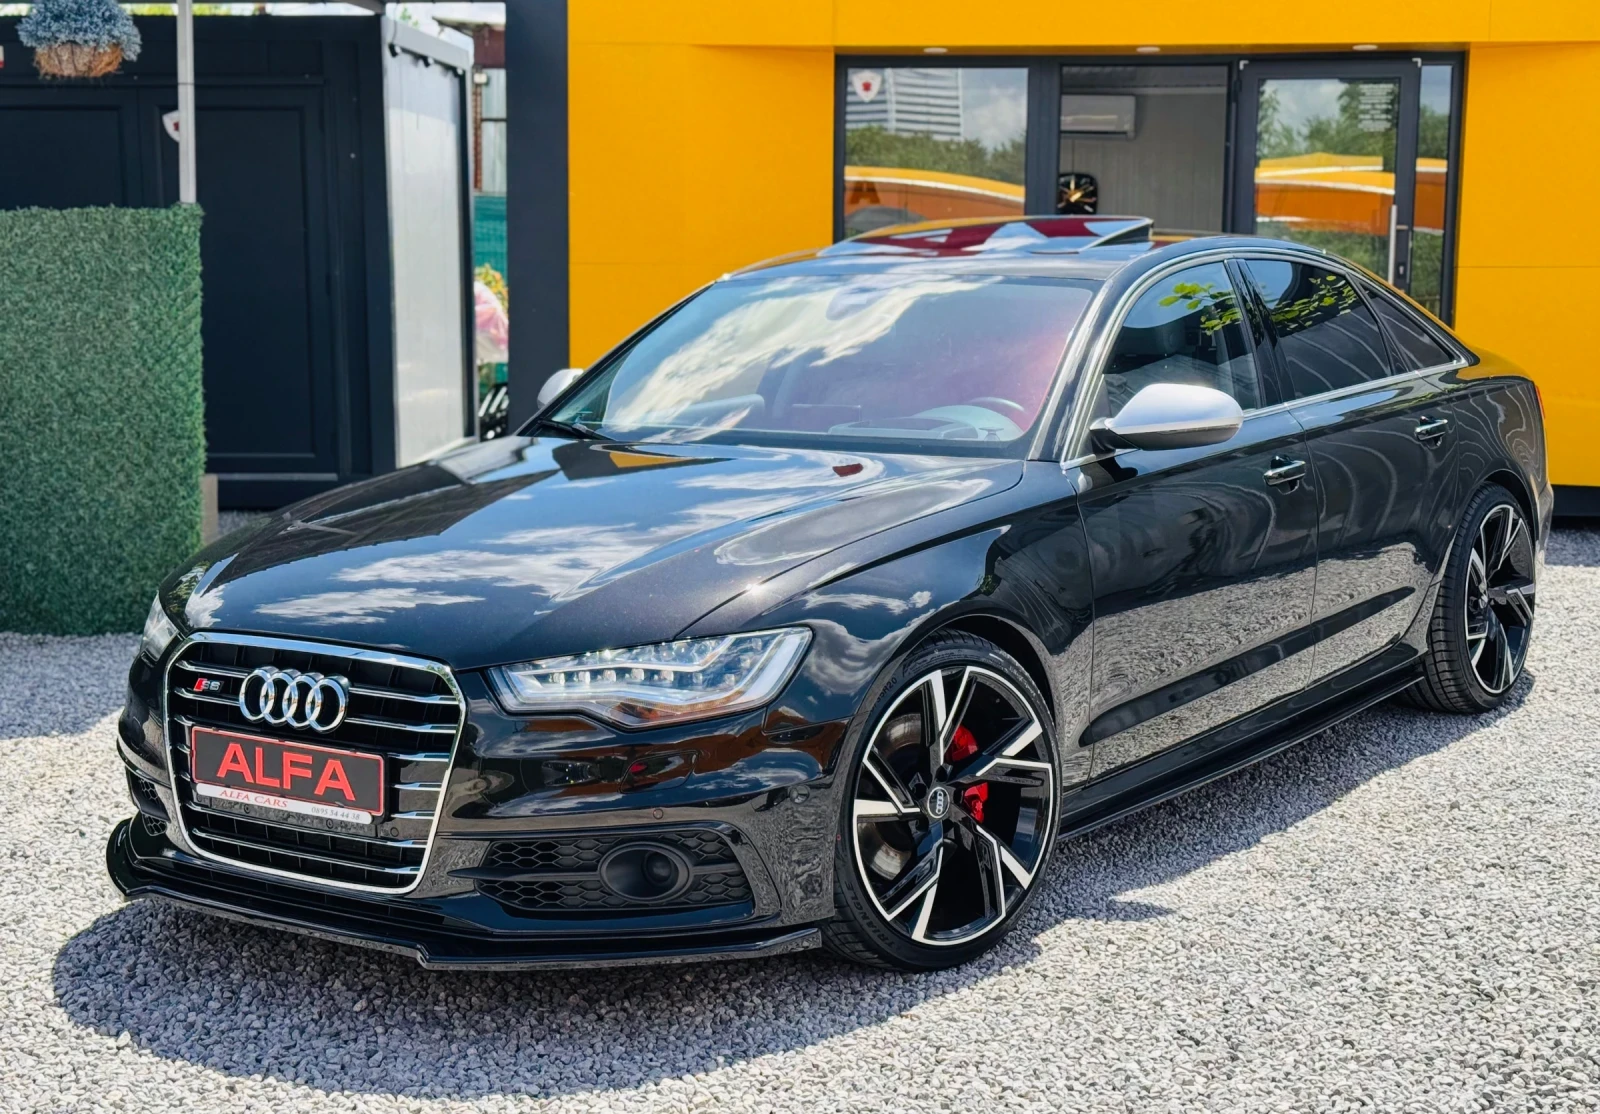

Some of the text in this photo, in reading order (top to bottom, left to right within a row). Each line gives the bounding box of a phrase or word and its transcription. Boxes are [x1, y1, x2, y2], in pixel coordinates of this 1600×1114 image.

[216, 742, 356, 802] ALFA
[219, 788, 288, 808] ALFA CARS
[311, 806, 328, 815] 0895
[329, 809, 339, 817] 54
[844, 880, 895, 948] TRIANGLE
